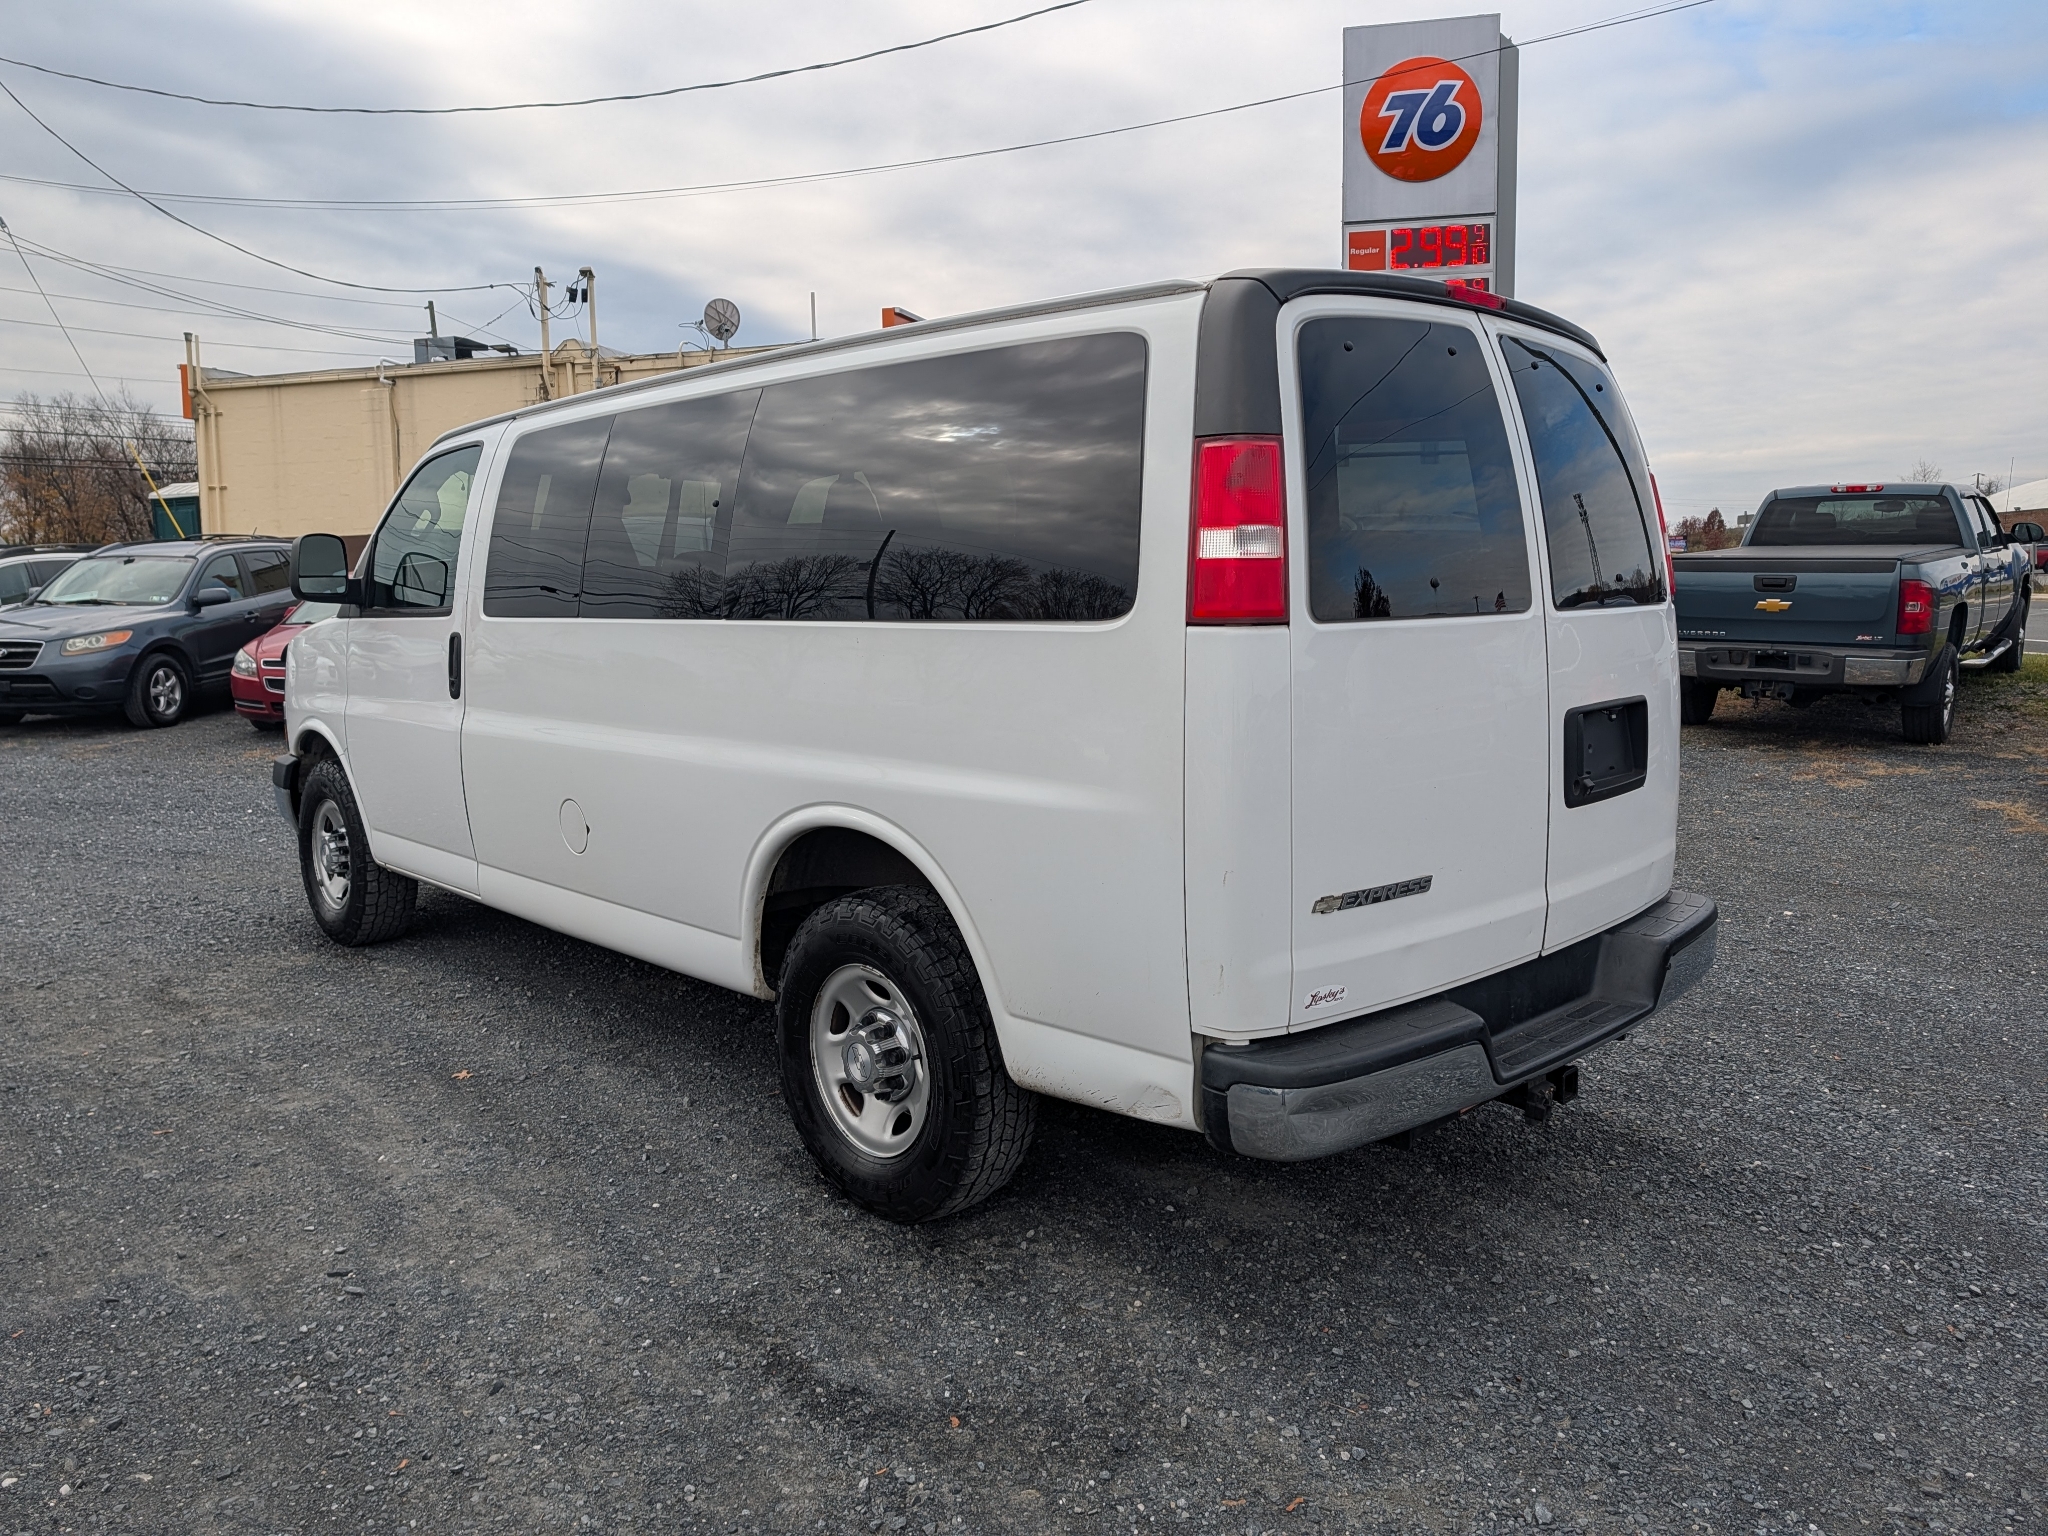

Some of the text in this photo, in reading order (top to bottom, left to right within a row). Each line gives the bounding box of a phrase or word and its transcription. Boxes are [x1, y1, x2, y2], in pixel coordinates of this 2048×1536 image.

[1378, 80, 1465, 154] 76
[1350, 247, 1380, 256] Regular
[1389, 225, 1467, 270] 2.99
[1340, 875, 1433, 911] EXPRESS
